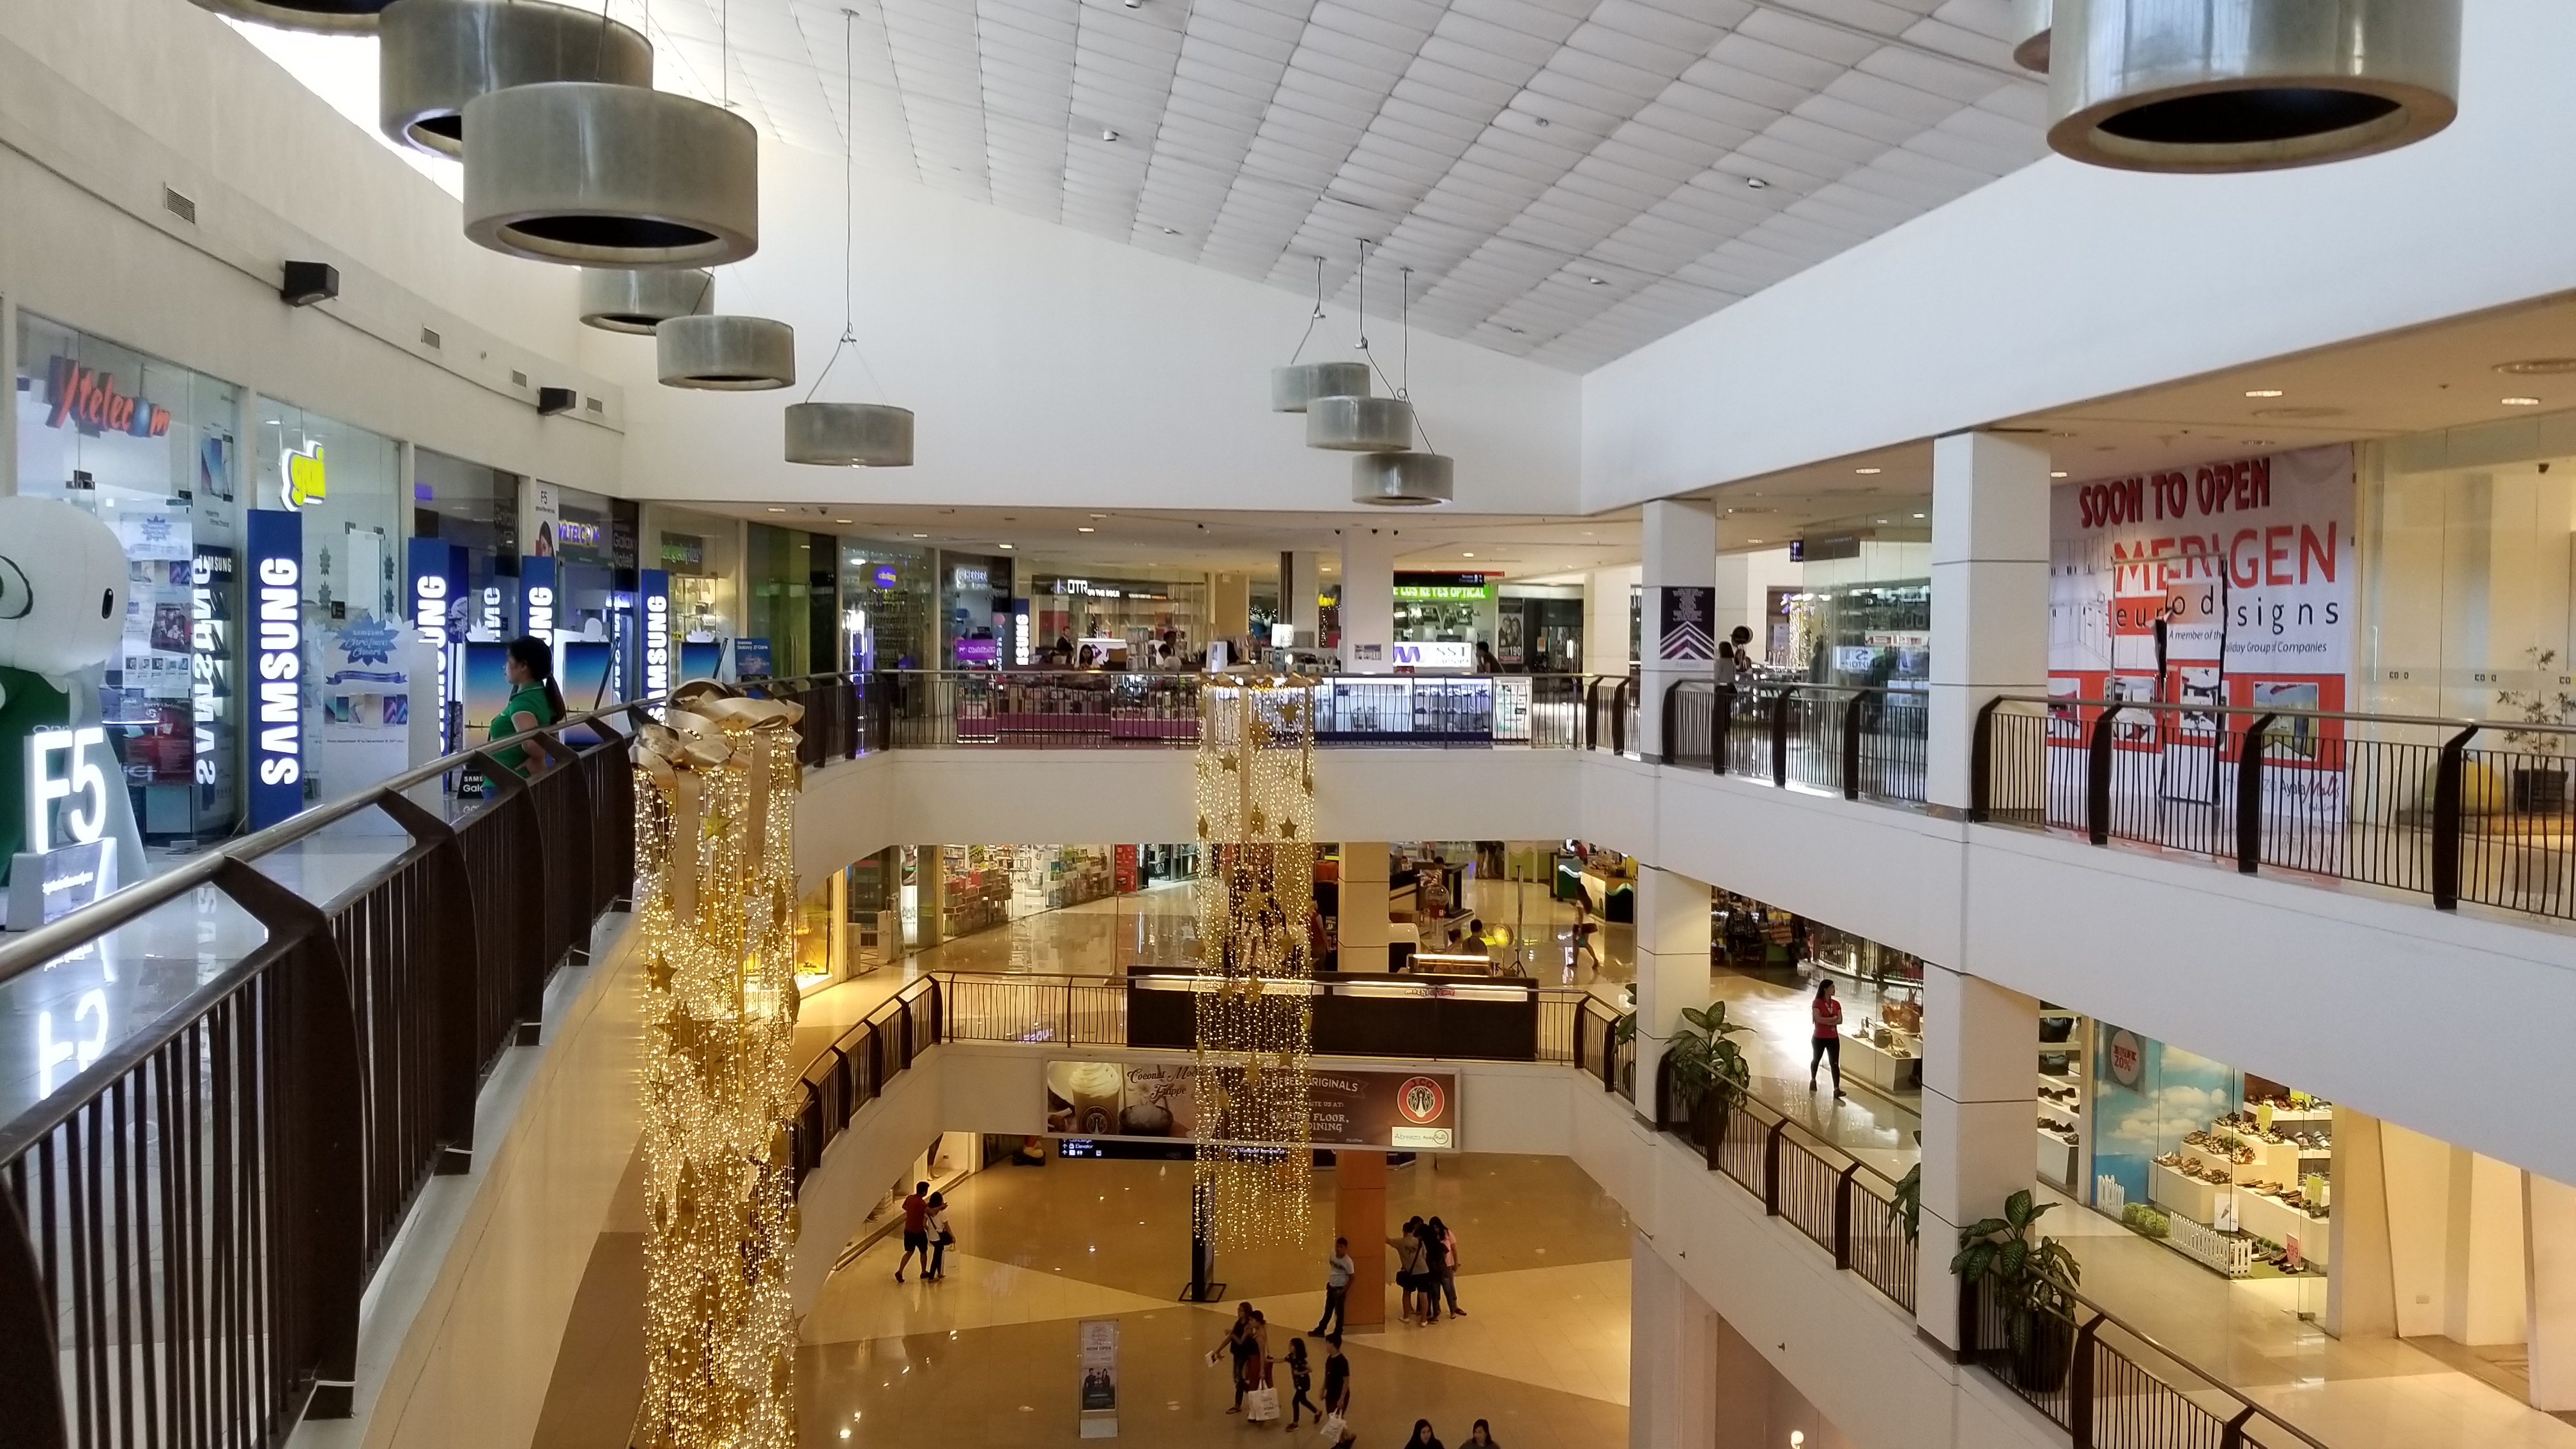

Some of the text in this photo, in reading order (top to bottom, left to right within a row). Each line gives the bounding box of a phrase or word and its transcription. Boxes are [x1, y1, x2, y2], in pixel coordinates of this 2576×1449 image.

[2080, 457, 2270, 528] SOON TO OPEN
[198, 555, 232, 572] SAMSUNG
[2115, 521, 2337, 592] MERIGEN
[1393, 586, 1485, 599] E LOS REYES OPTICAL
[1016, 614, 1029, 665] SUNG
[2175, 629, 2203, 640] member
[2204, 629, 2214, 640] of
[2214, 629, 2222, 640] th
[1509, 646, 1521, 656] 190
[2247, 641, 2270, 655] Group
[2278, 641, 2327, 654] Companies
[259, 558, 299, 785] SAMSUNG
[34, 727, 105, 854] F5
[2114, 1055, 2131, 1071] 20%
[1127, 1068, 1166, 1084] Coconut
[1151, 1084, 1187, 1099] Frappe
[1305, 1077, 1358, 1092] ORIGINALS
[1313, 1113, 1349, 1124] FLOOR,
